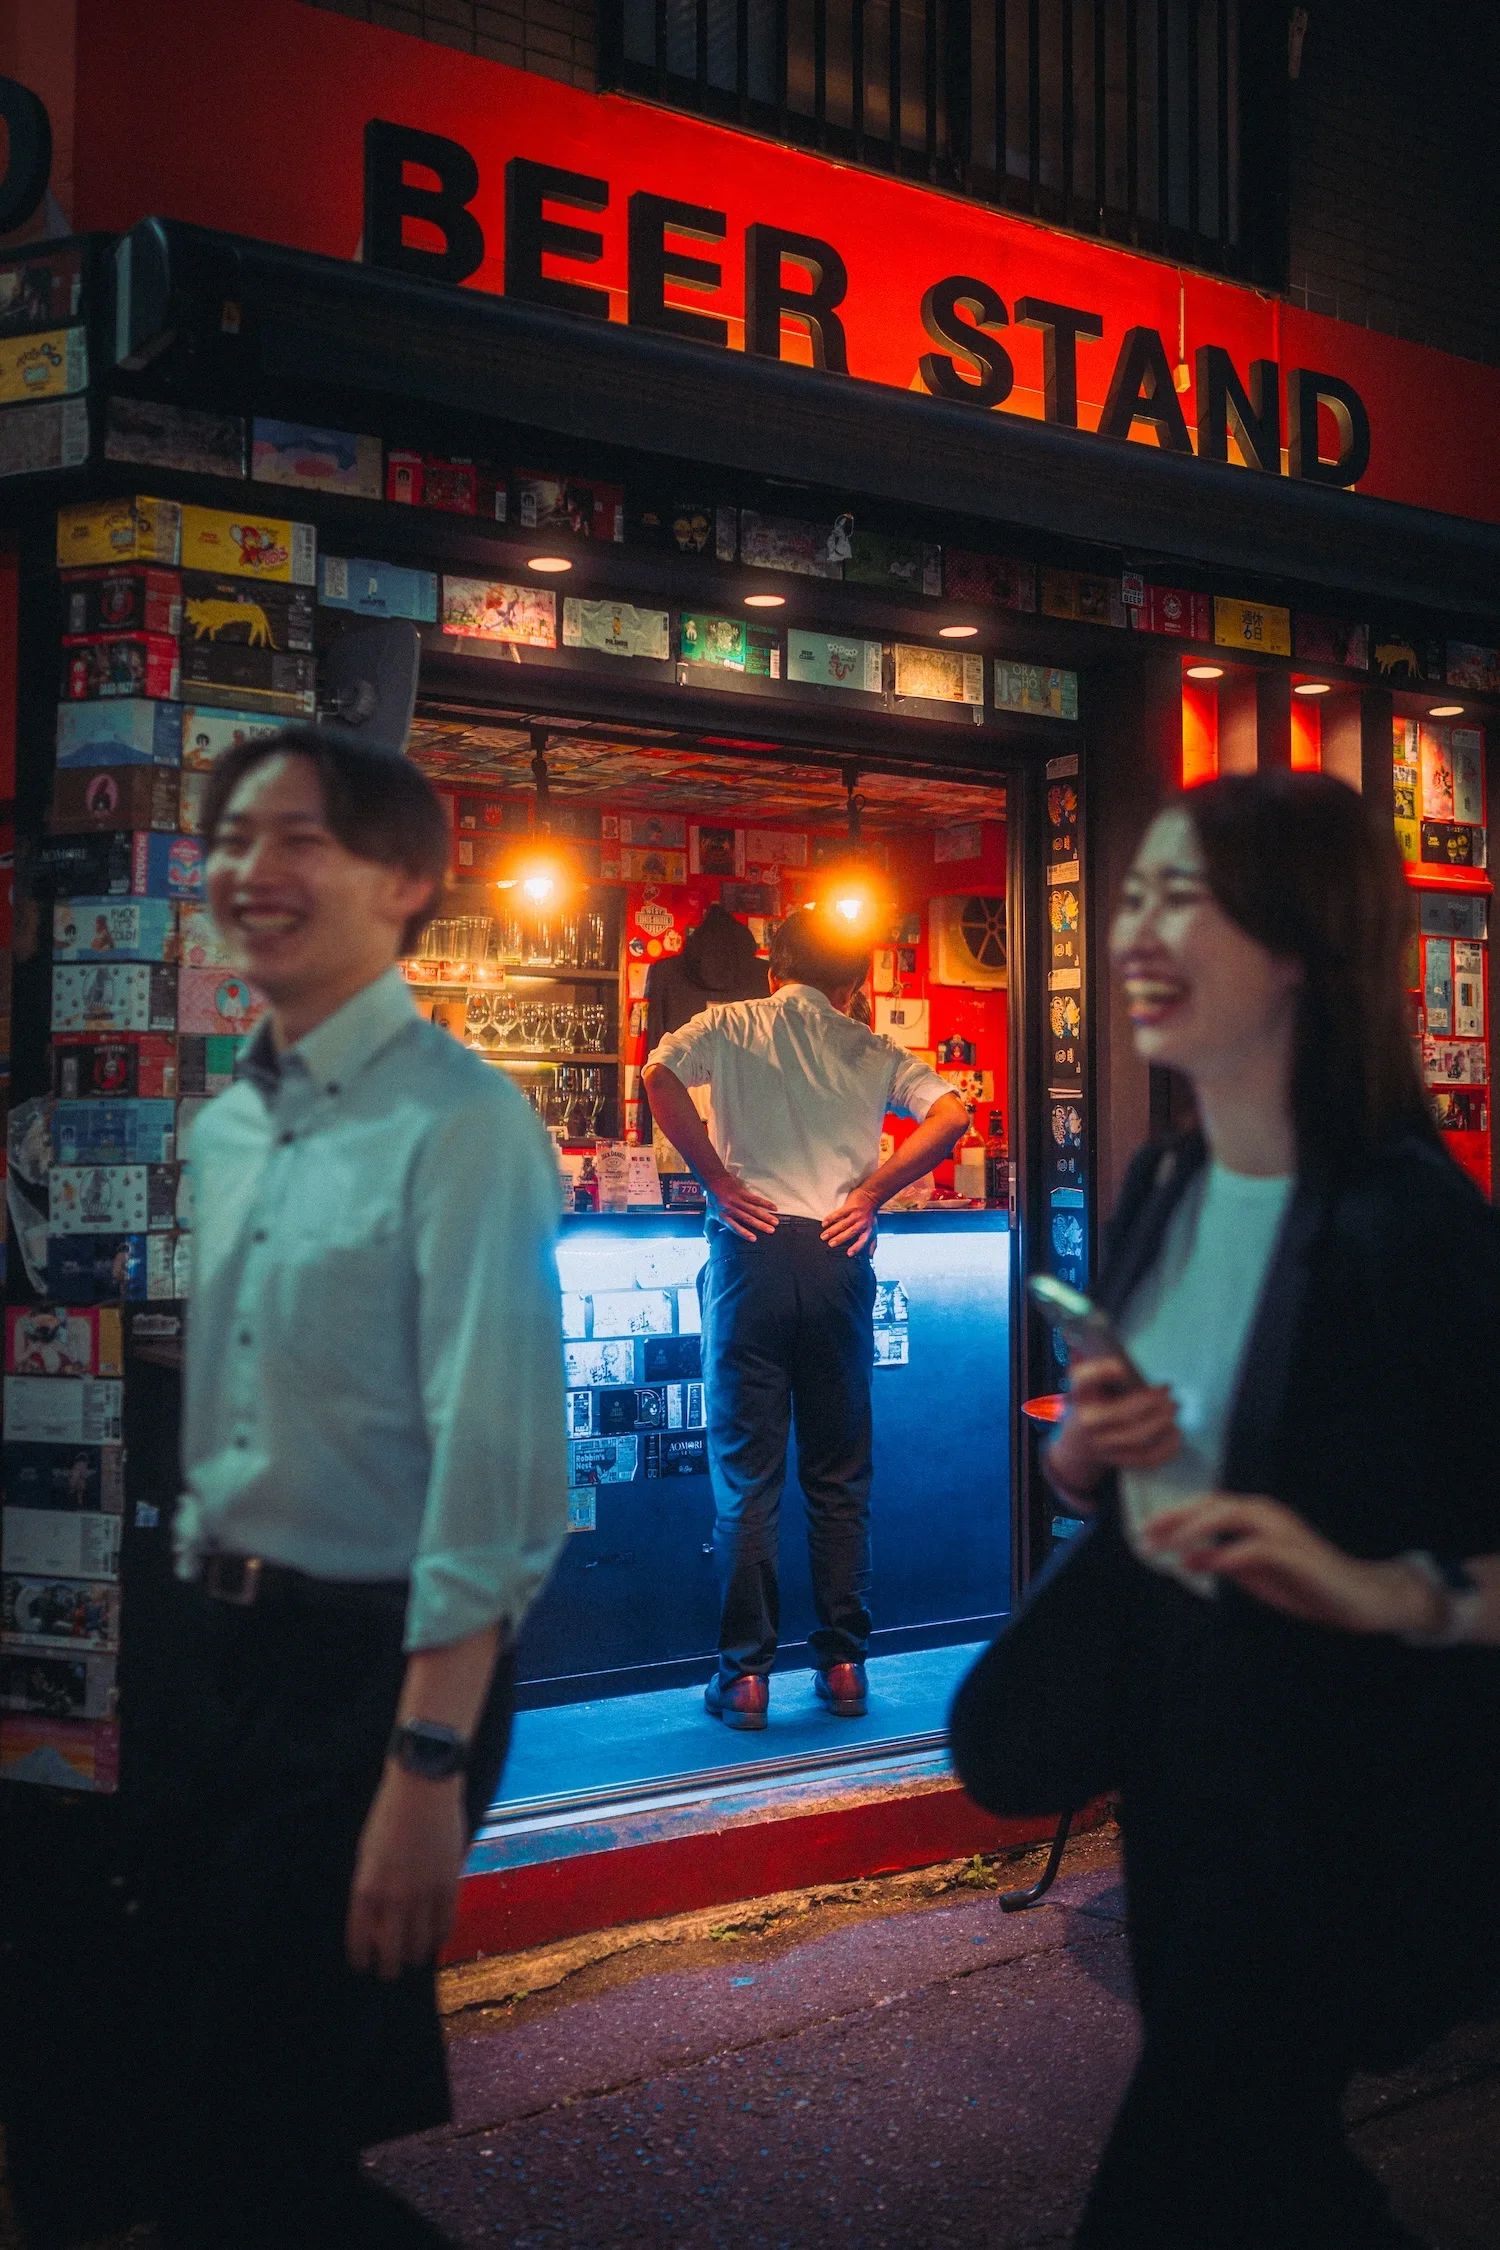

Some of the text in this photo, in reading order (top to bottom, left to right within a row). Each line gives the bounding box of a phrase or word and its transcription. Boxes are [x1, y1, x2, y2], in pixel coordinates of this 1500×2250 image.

[363, 118, 1371, 489] BEER STAND
[1124, 595, 1142, 605] BEER
[1012, 664, 1038, 678] ORA
[1021, 677, 1038, 689] HO
[681, 1185, 697, 1194] 770
[668, 1440, 703, 1452] AOMORI
[575, 1453, 605, 1462] Robbin's
[575, 1462, 592, 1470] Nest
